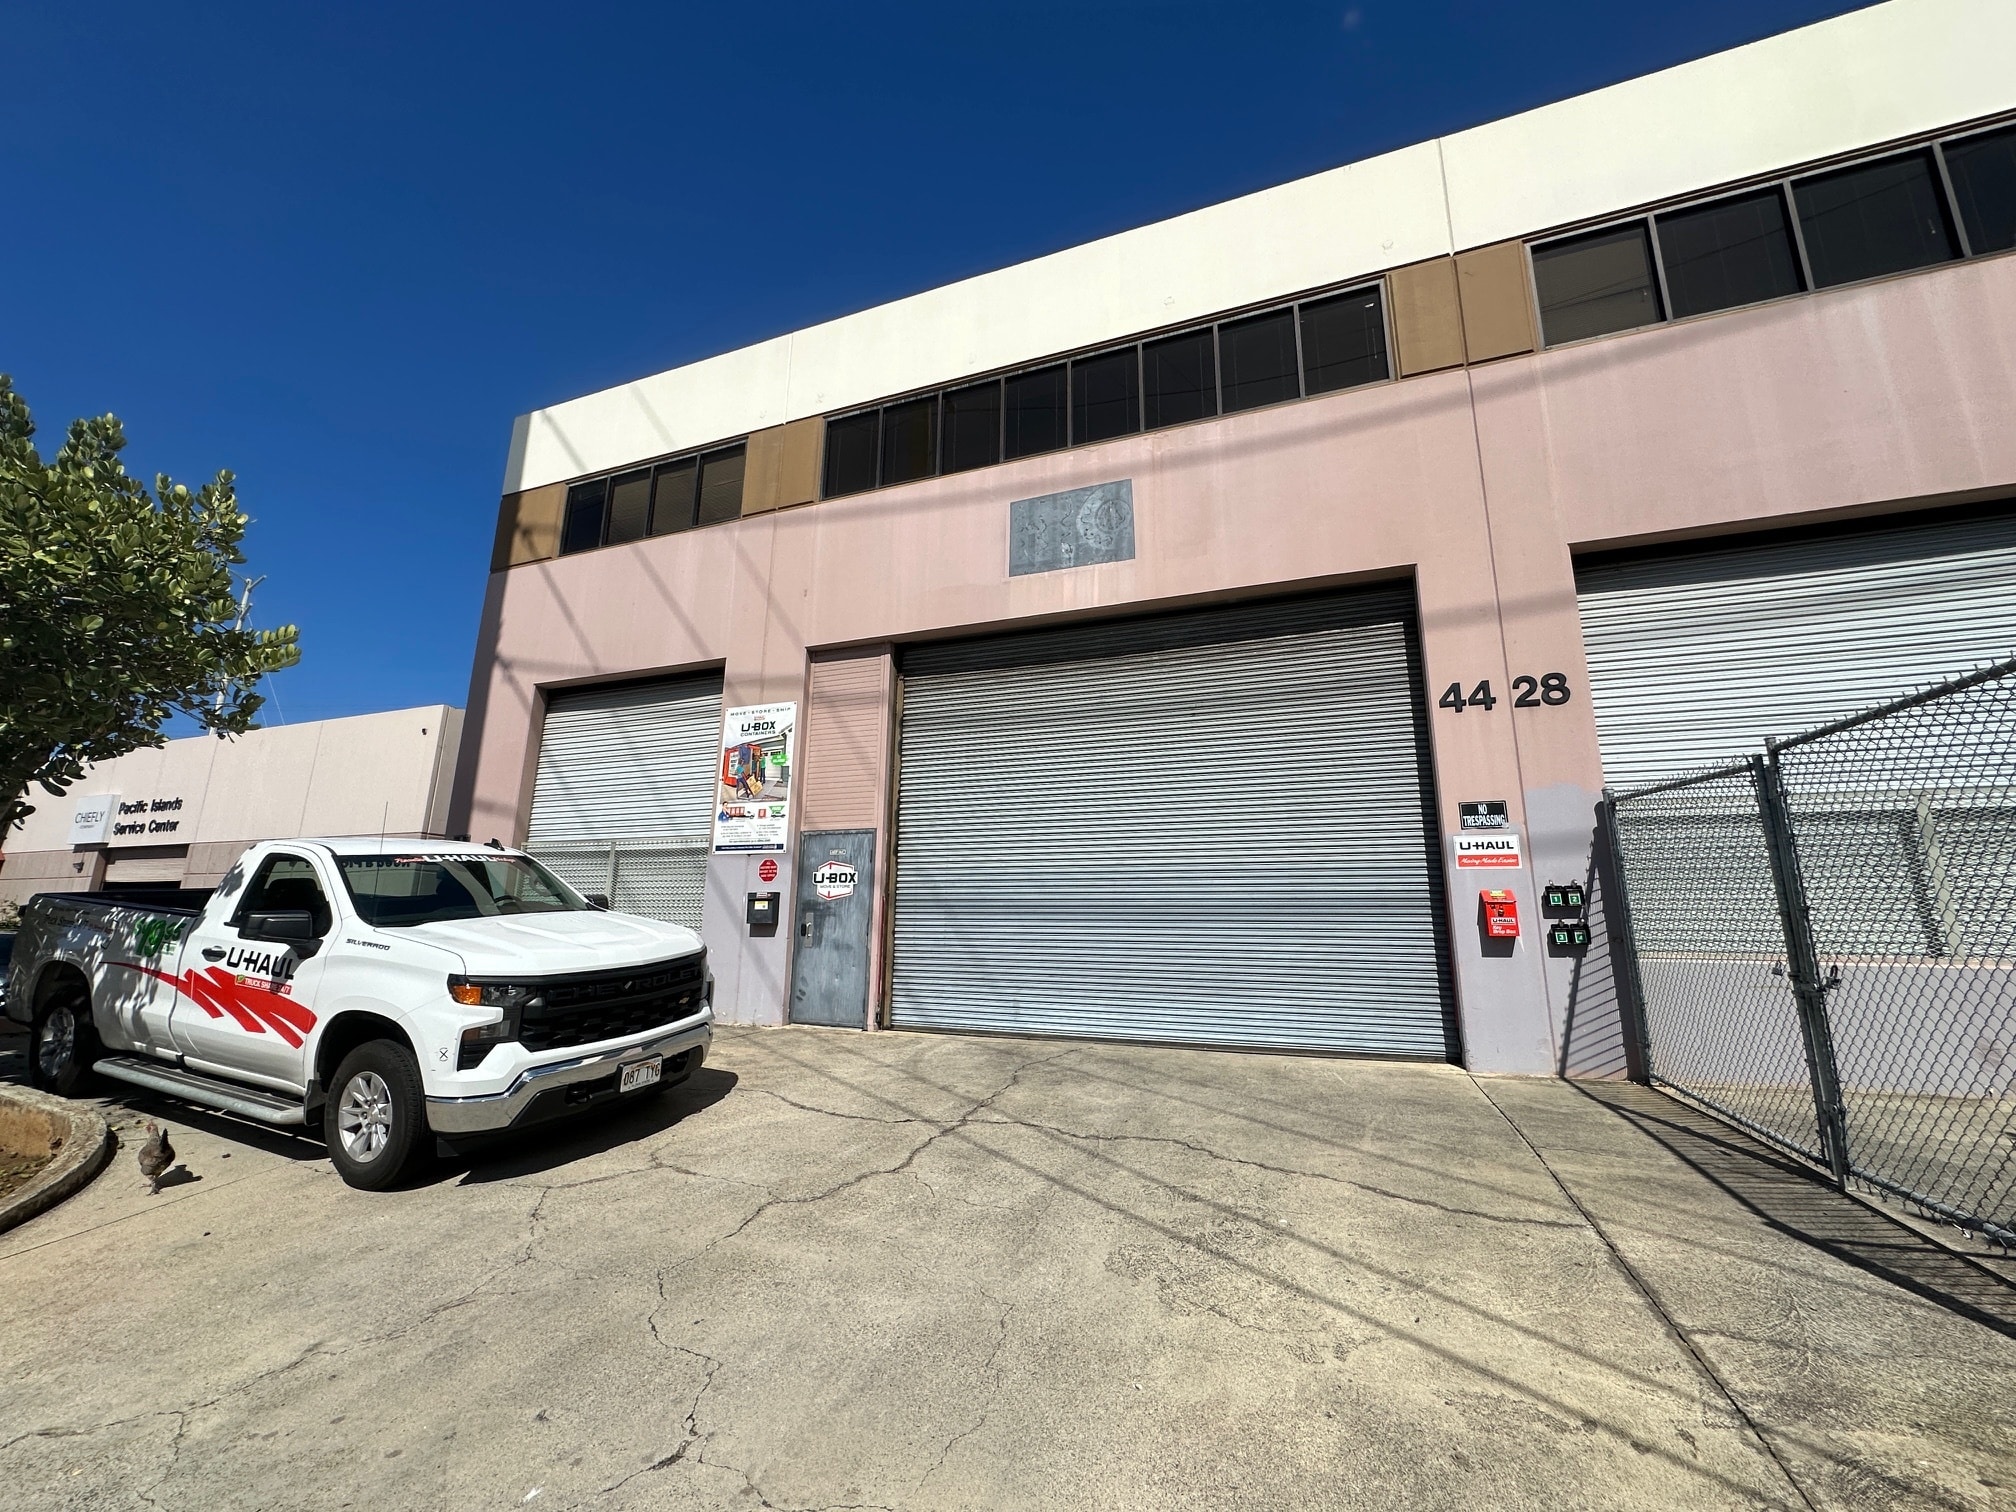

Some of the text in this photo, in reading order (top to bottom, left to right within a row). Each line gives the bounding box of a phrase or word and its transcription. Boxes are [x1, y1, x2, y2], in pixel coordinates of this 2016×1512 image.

[1438, 672, 1571, 713] 44 28
[741, 721, 776, 732] U-BOX
[118, 797, 183, 815] Pacific Islands
[1477, 803, 1488, 814] NO
[74, 811, 106, 824] CHIEFLY
[1463, 814, 1506, 827] TRESPASSING
[113, 819, 180, 836] Service Center
[1459, 840, 1515, 851] U-HAUL
[422, 853, 498, 863] U-HAUL
[1461, 856, 1518, 865] Moving Made Easier
[813, 872, 857, 884] U-BOX
[346, 938, 391, 951] SILVERADO
[226, 946, 295, 980] U-HAUL
[244, 977, 261, 988] TRUCK
[548, 967, 700, 1000] CHEVROLET
[623, 1068, 641, 1086] 087
[644, 1062, 661, 1080] TYG
